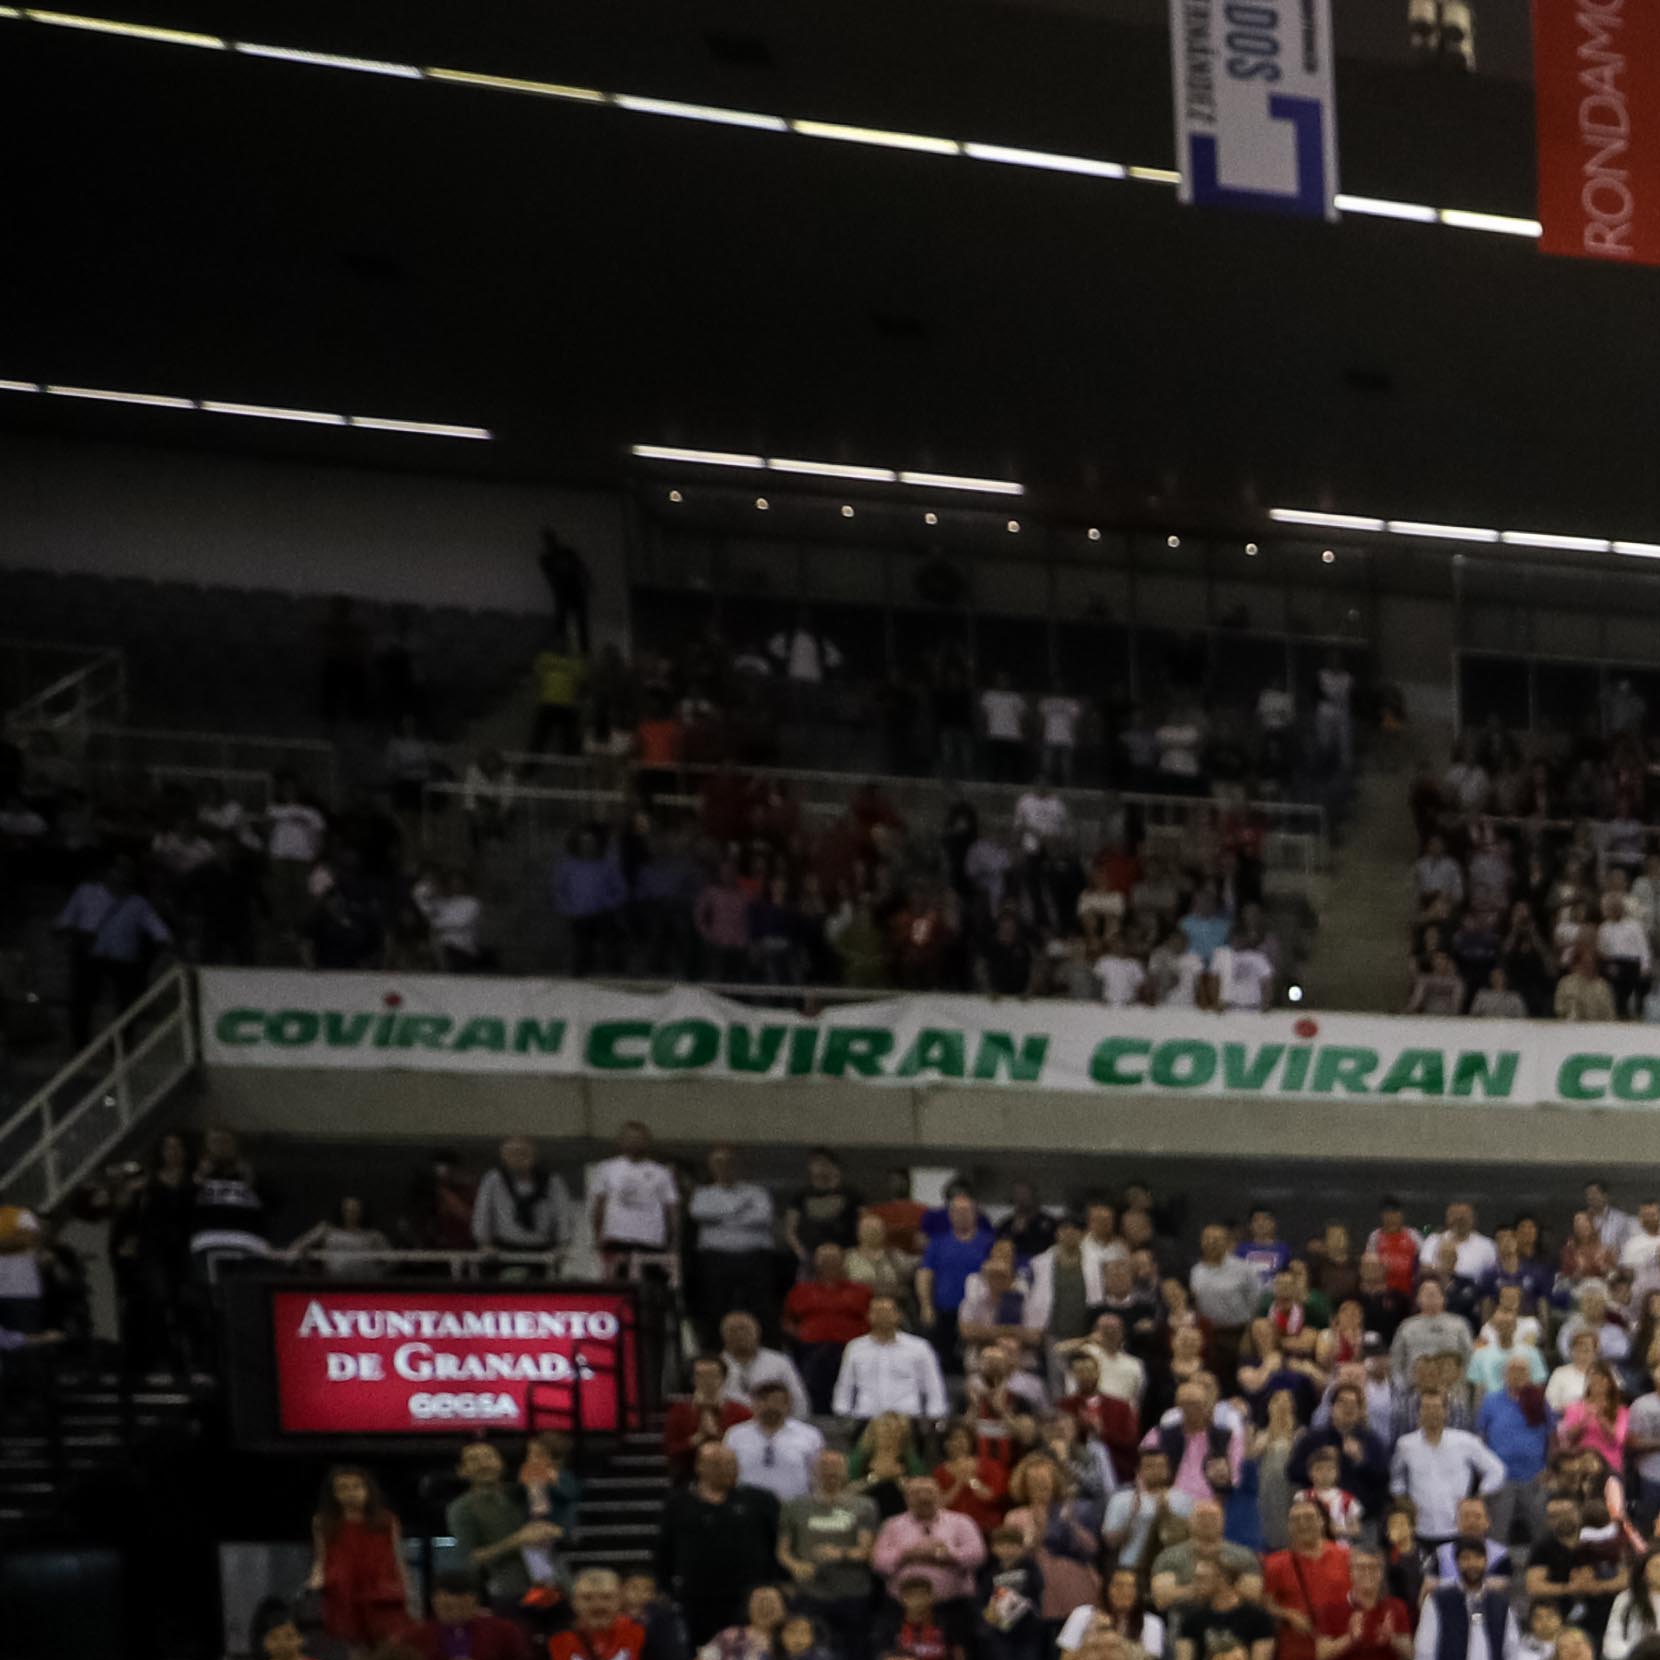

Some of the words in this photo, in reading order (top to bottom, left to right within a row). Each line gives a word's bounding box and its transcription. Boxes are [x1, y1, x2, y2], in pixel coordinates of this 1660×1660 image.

[1576, 0, 1634, 254] RONDAM
[585, 1017, 1050, 1081] COVIRAN
[297, 1300, 619, 1339] AYUNTAMIENTO
[326, 1352, 385, 1382] DE
